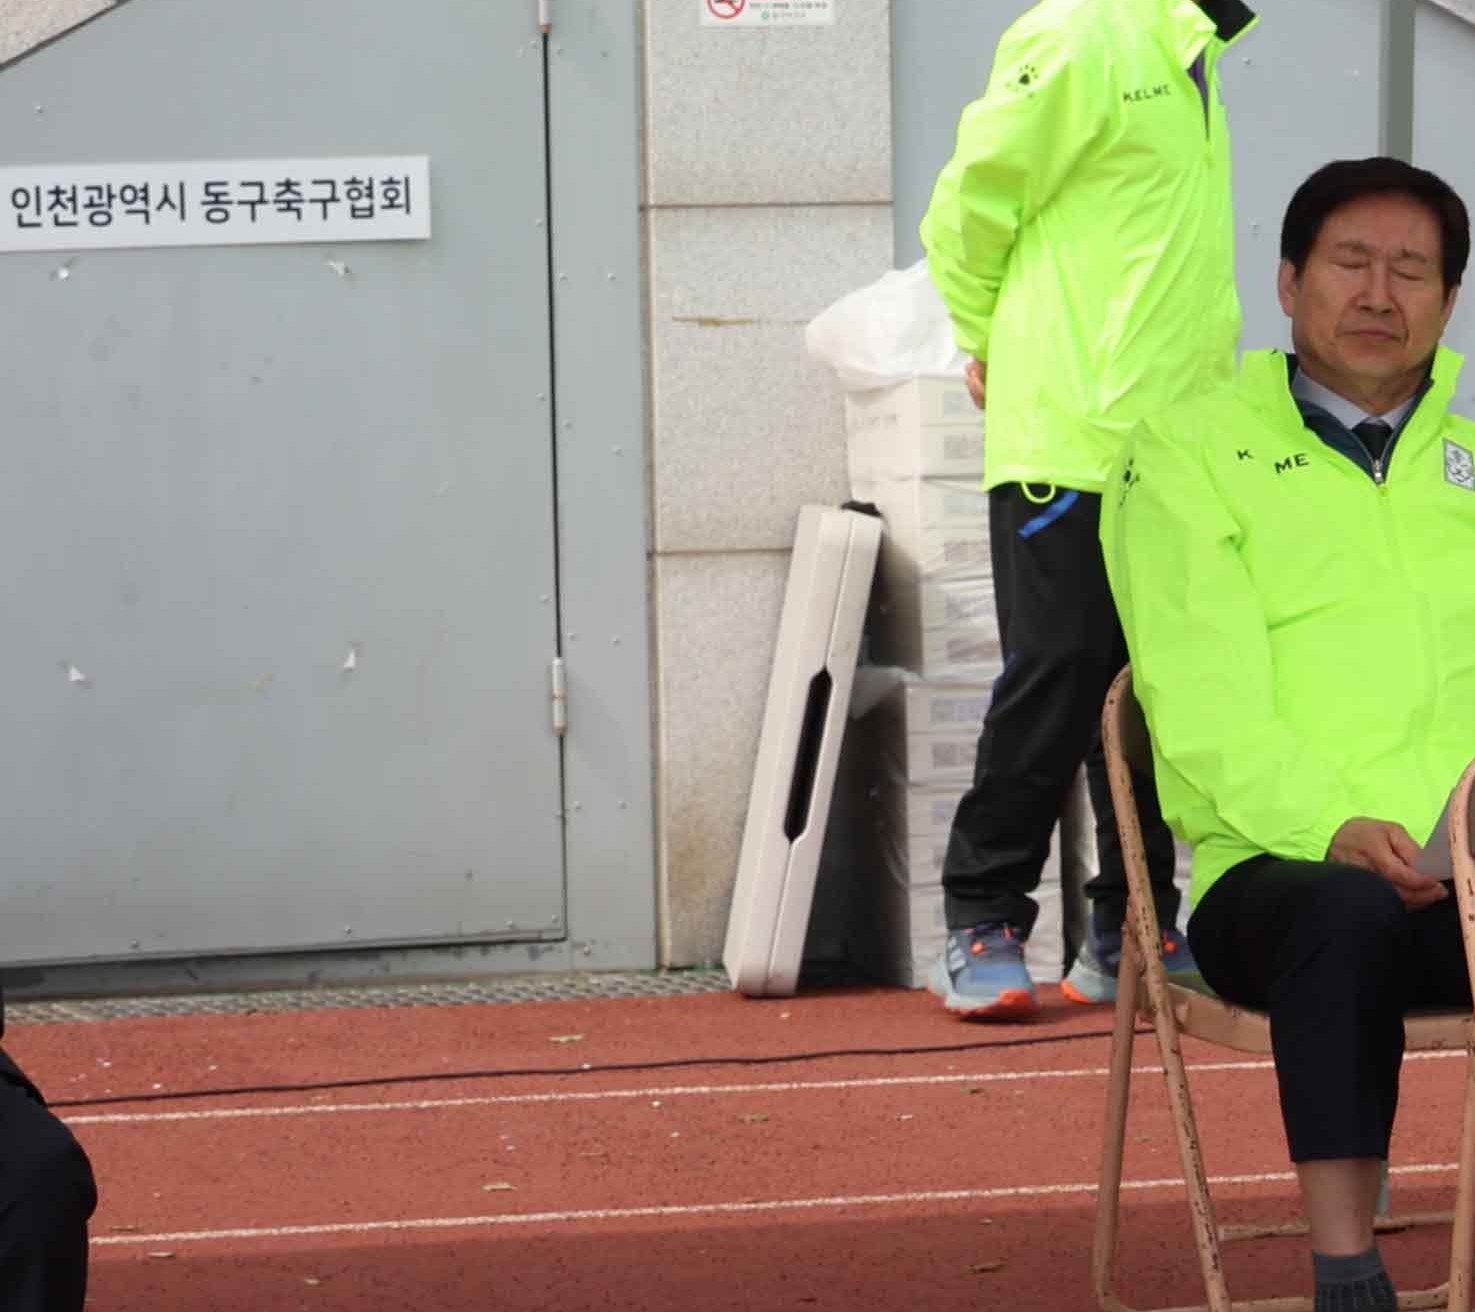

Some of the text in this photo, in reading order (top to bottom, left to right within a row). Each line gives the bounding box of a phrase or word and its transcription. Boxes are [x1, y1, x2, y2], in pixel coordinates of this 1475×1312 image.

[10, 175, 411, 229] 인천광역시 동구축구협회
[1237, 449, 1310, 474] KME
